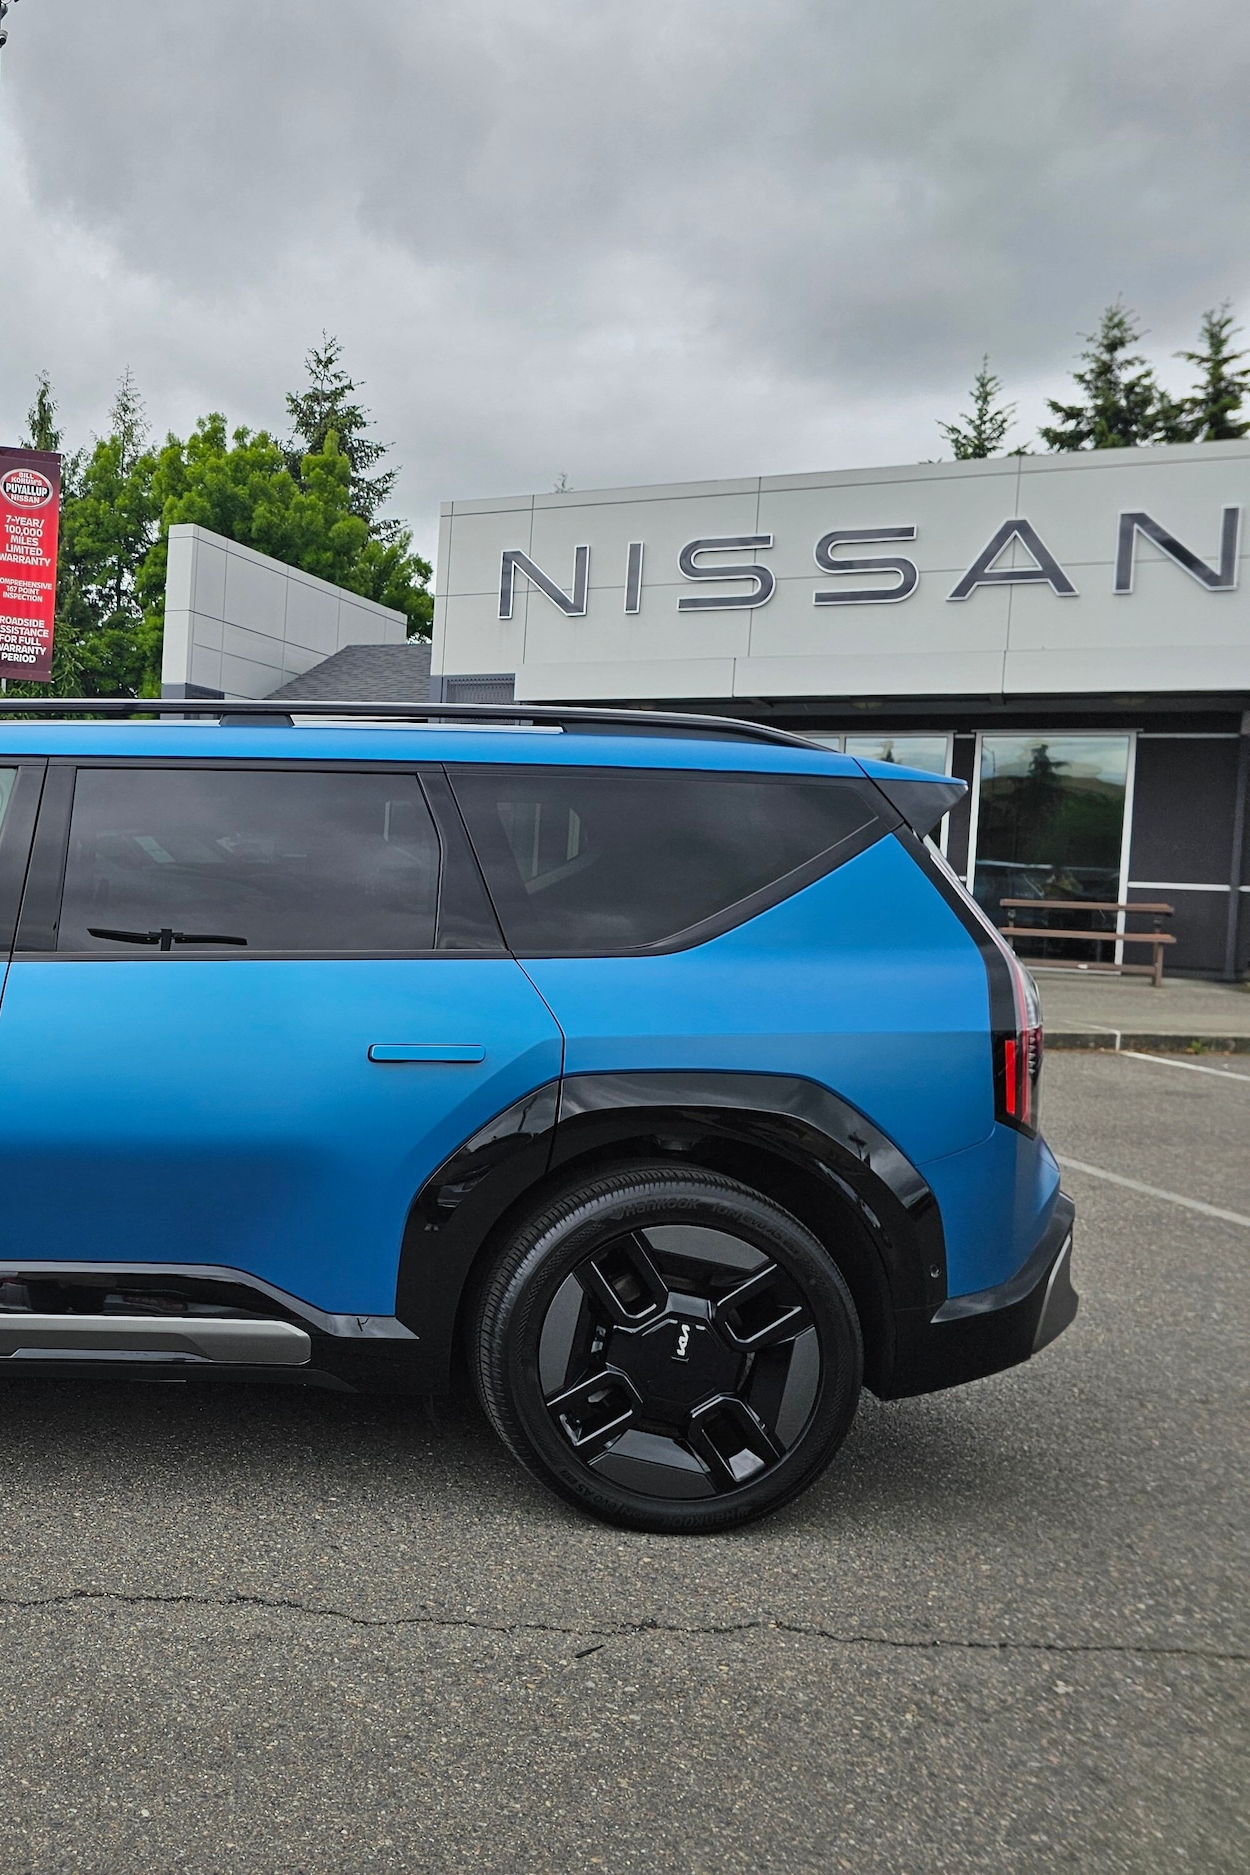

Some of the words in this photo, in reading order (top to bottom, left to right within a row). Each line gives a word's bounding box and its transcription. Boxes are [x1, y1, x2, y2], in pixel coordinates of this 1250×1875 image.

[11, 476, 43, 486] KORUM'S
[5, 483, 48, 497] PUYALLUP
[10, 493, 40, 504] NISSAN
[5, 514, 45, 528] 7-YEAR/
[4, 524, 43, 537] 100,000
[10, 535, 39, 546] MILES
[5, 543, 43, 556] LIMITED
[498, 504, 1242, 620] NISSAN
[2, 591, 43, 602] INSPECTION
[18, 586, 40, 595] POINT
[0, 615, 45, 628] ROADSIDE
[18, 635, 42, 646] FULL
[1, 652, 37, 664] PERIOD
